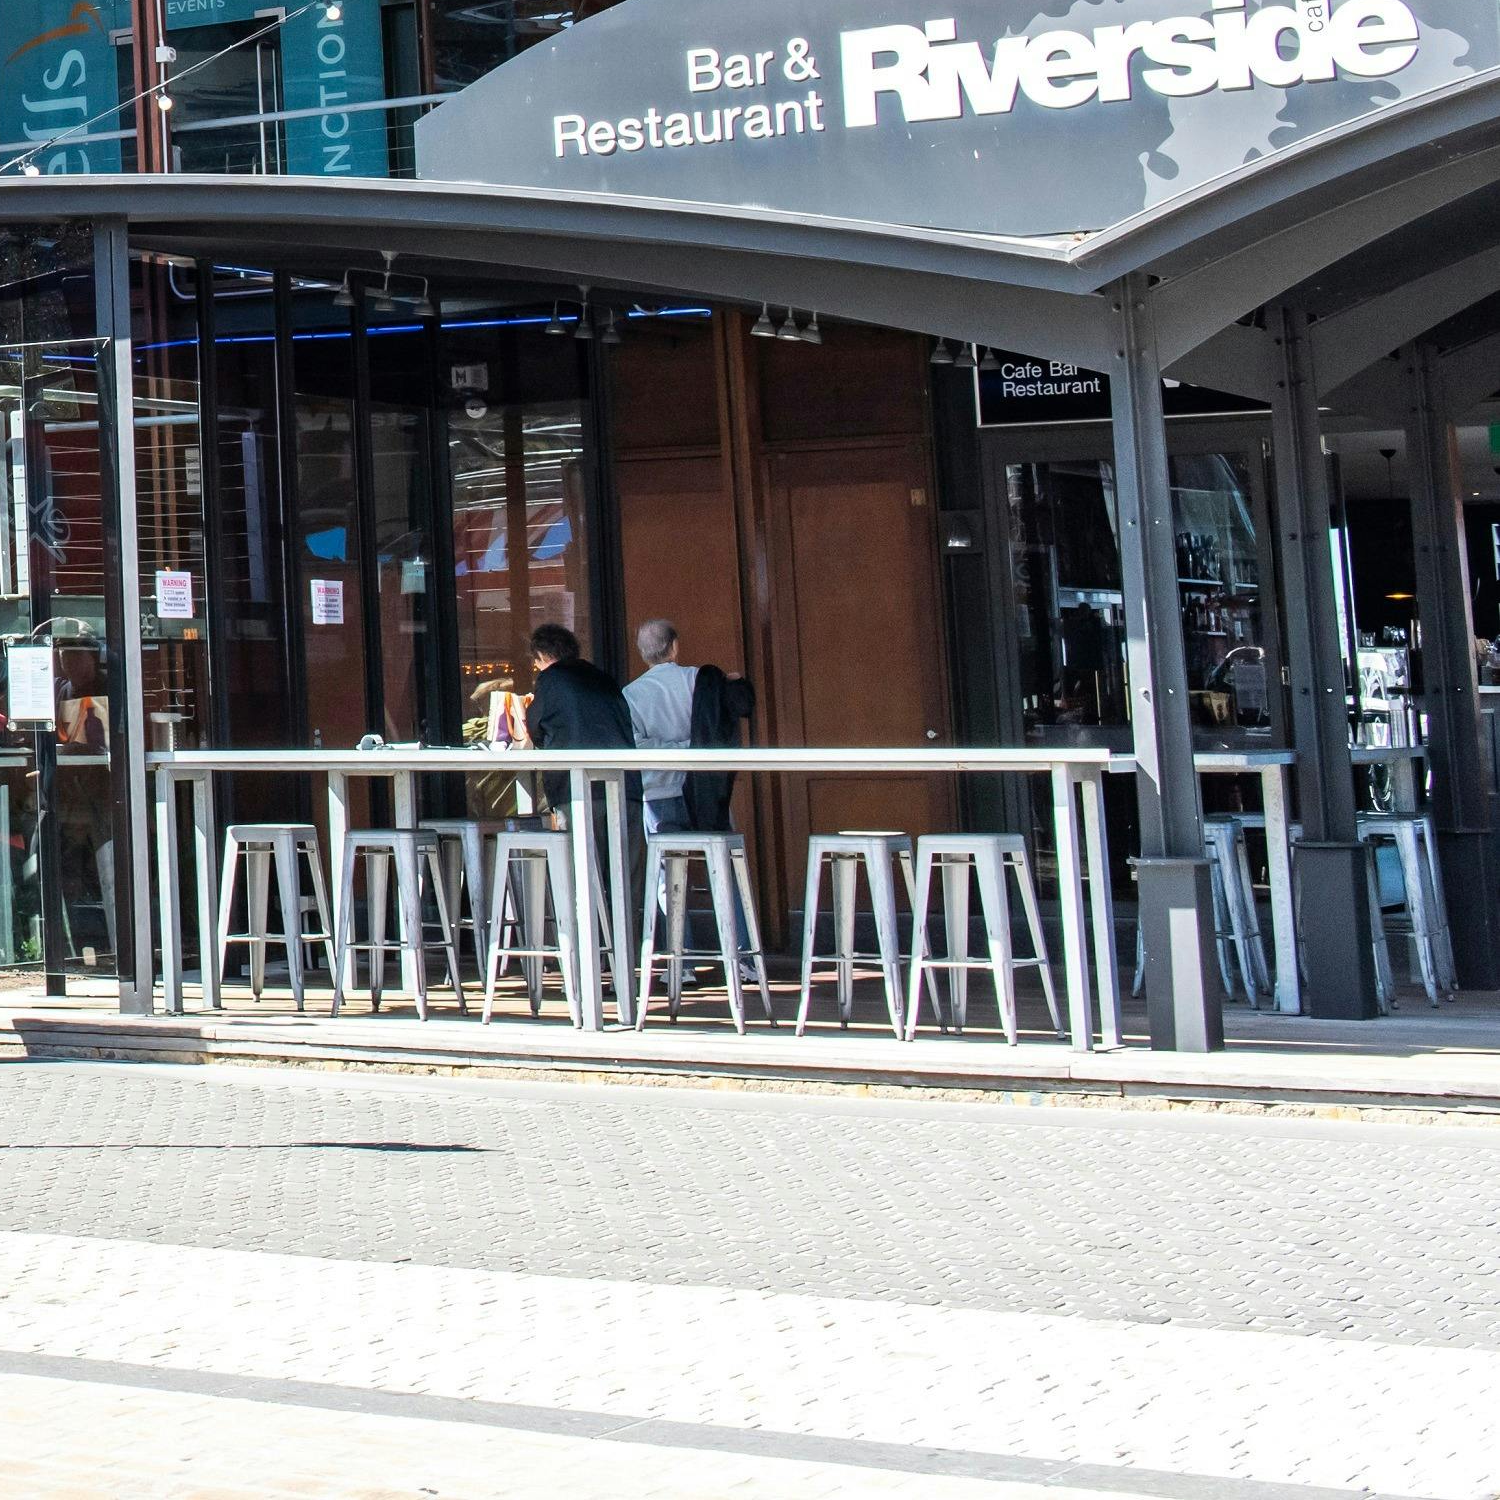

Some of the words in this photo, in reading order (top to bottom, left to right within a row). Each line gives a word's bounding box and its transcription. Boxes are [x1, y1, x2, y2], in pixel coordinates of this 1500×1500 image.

[686, 46, 776, 93] Bar
[783, 35, 822, 83] &
[21, 49, 90, 175] ells
[552, 92, 825, 159] Restaurant
[1001, 362, 1043, 380] Cafe
[1002, 377, 1101, 398] Restaurant
[162, 579, 187, 587] WARNING
